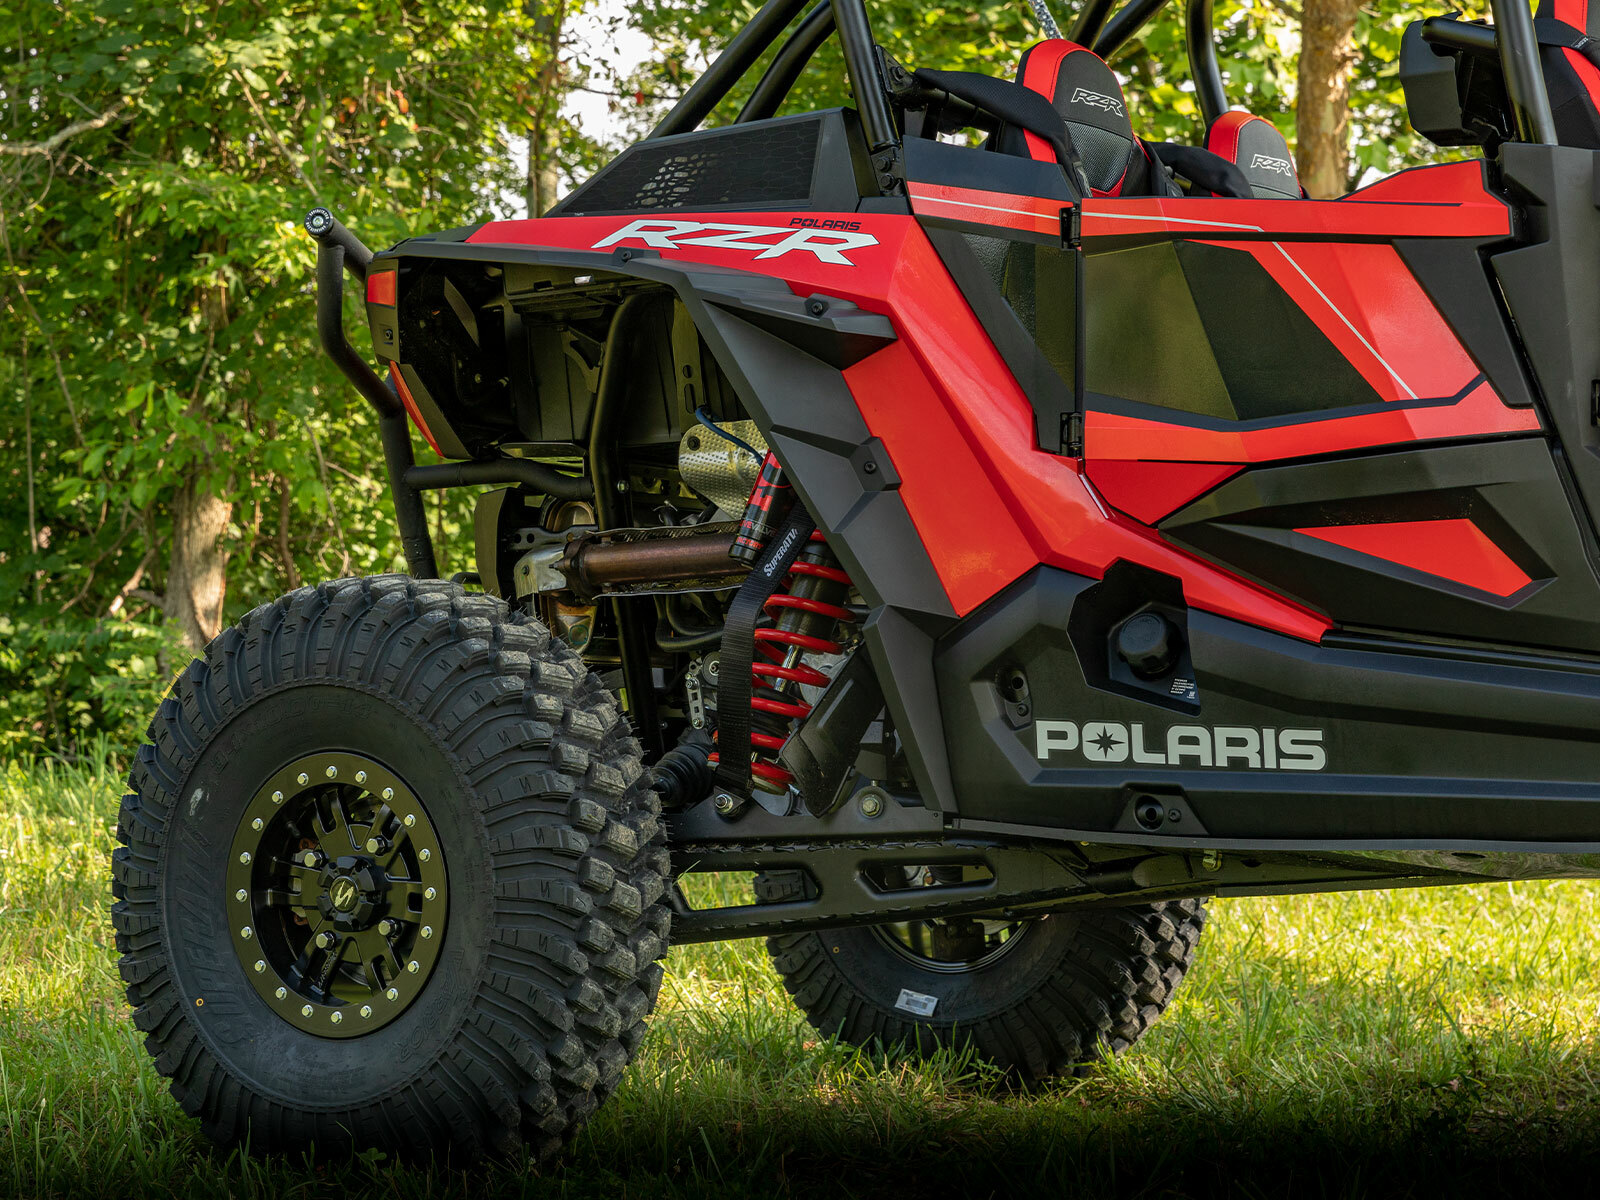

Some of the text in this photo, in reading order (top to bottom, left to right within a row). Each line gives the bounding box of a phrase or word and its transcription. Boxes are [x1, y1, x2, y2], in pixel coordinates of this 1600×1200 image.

[1071, 88, 1123, 117] RZR
[1251, 154, 1291, 176] RZR
[789, 217, 862, 231] POLARIS
[591, 219, 880, 267] RZR
[1035, 719, 1327, 771] POLARIS
